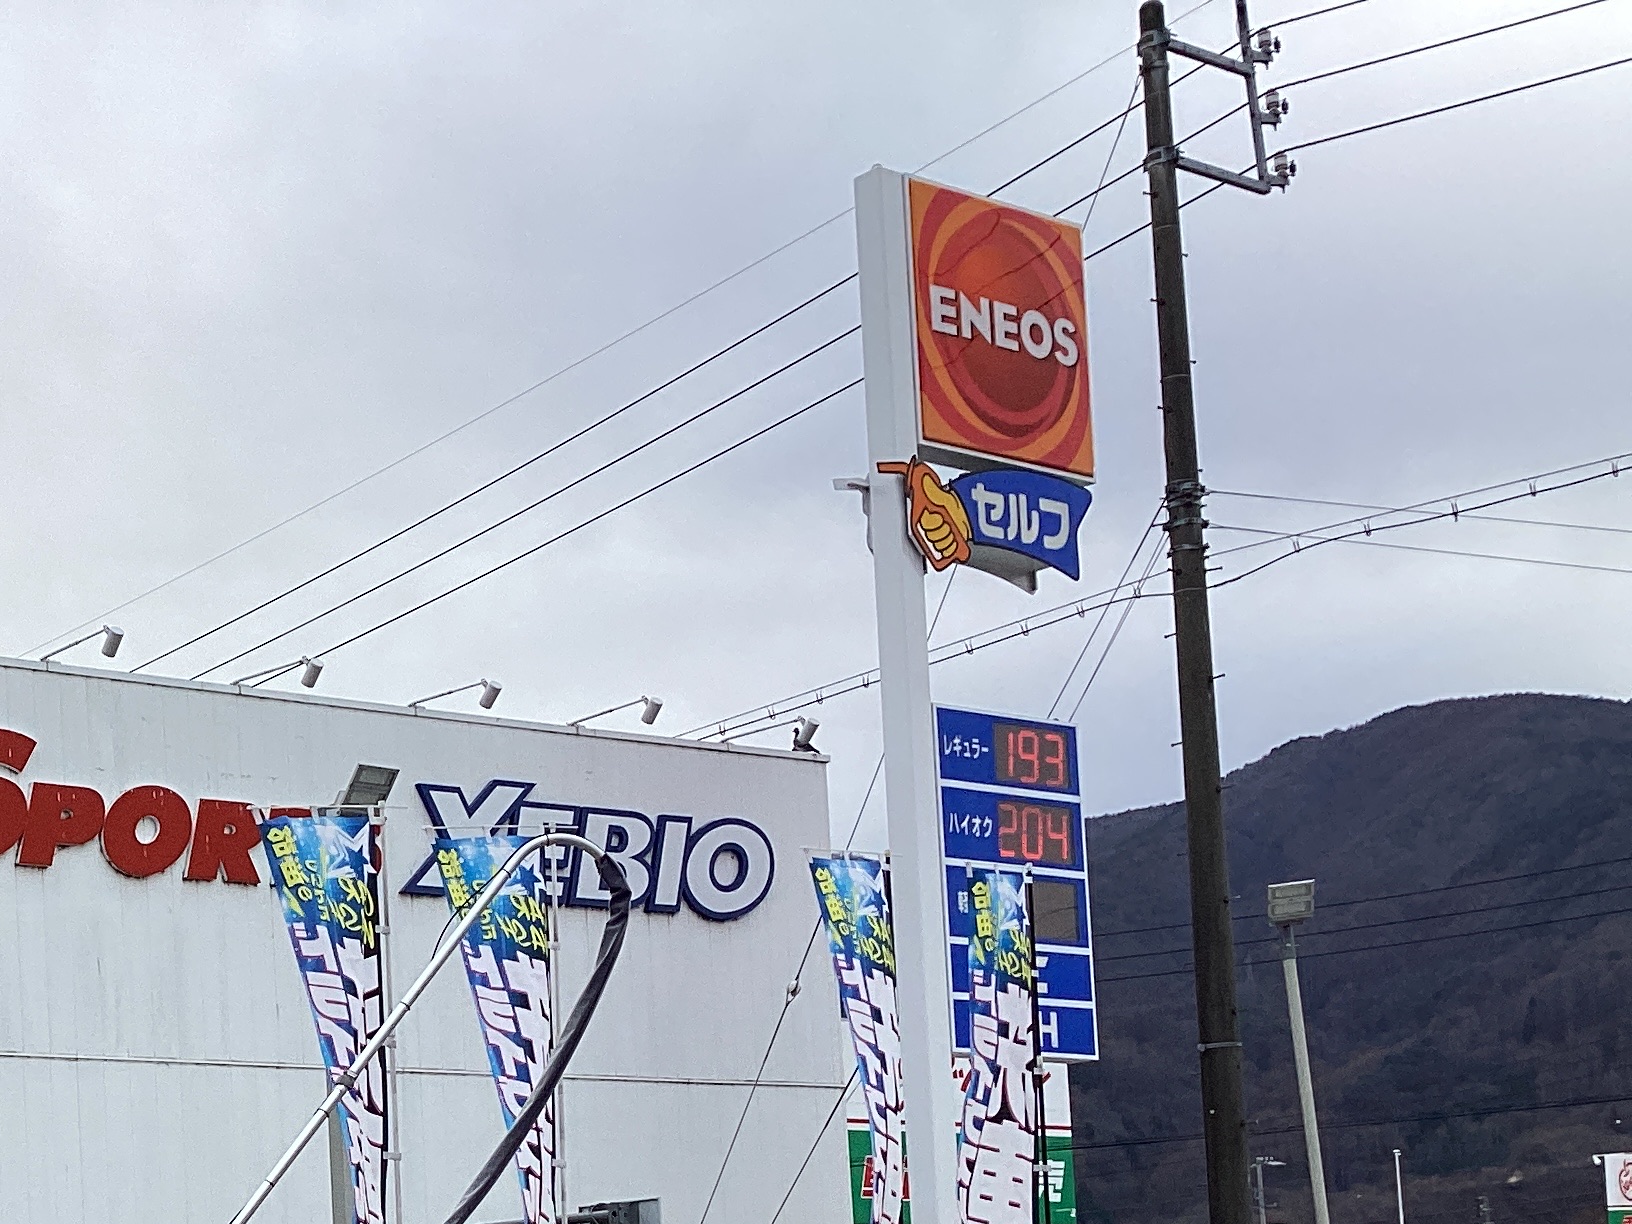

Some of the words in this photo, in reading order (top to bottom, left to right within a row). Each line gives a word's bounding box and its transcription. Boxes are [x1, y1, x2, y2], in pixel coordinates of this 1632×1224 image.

[930, 285, 1078, 366] ENEOS
[971, 483, 1070, 549] セルフ
[944, 735, 989, 759] レギュラー
[1007, 730, 1063, 786] 193
[949, 812, 993, 838] ハイオク
[998, 803, 1068, 860] 204
